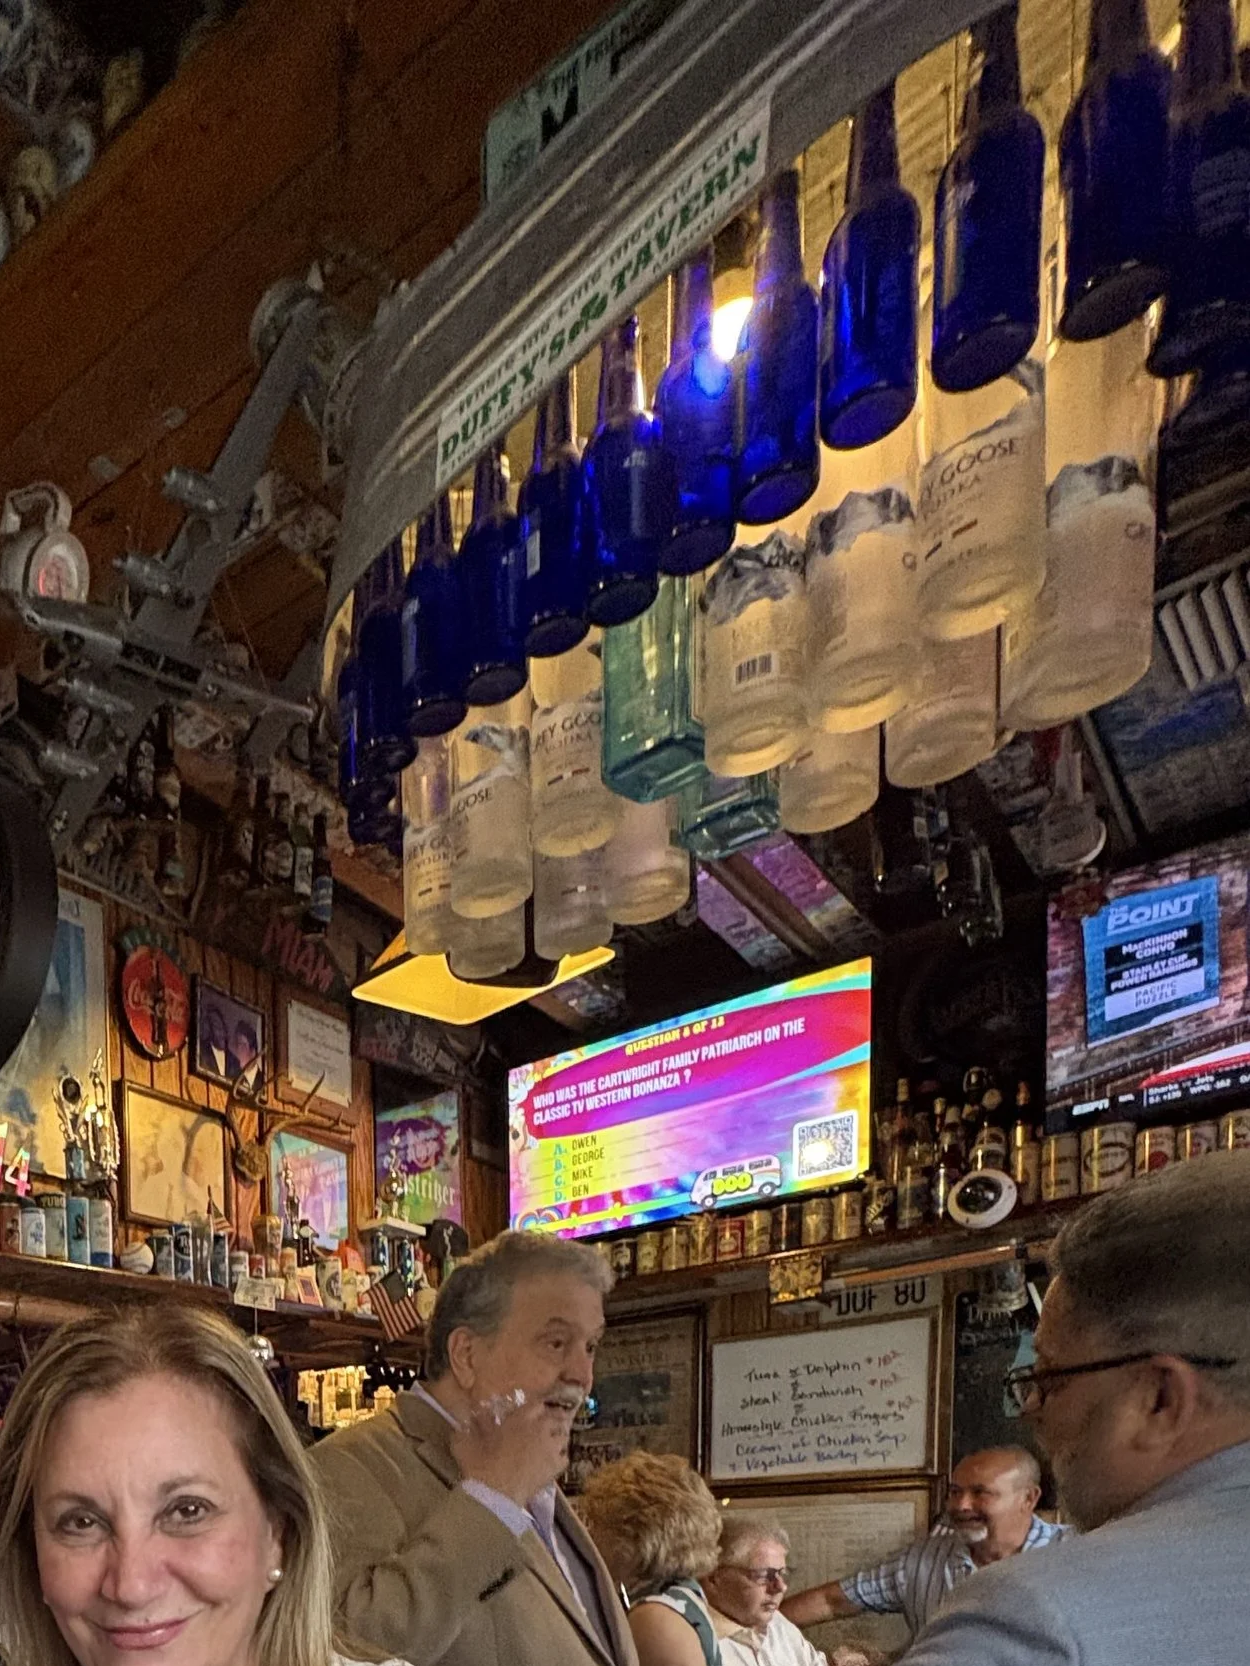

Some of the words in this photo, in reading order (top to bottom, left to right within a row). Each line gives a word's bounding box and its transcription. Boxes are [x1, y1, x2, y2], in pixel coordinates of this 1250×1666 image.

[441, 331, 566, 464] DUFFY'S
[612, 134, 760, 294] TAVERN
[940, 438, 1021, 487] GOOSE
[1108, 893, 1200, 934] POINT
[1135, 942, 1176, 959] CONVO
[1122, 959, 1166, 980] STANLEY
[1168, 953, 1188, 967] CUP
[1110, 974, 1148, 992] POWER
[1135, 980, 1177, 998] PACIFIC
[1135, 989, 1177, 1008] PUZZLE
[624, 1028, 680, 1056] QUESTION
[693, 1022, 707, 1036] OF
[533, 1092, 555, 1110] WHO
[556, 1086, 577, 1104] WAS
[578, 1080, 597, 1099] THE
[597, 1060, 661, 1090] CARTWRIGHT
[662, 1047, 701, 1074] FAMILY
[701, 1028, 762, 1060] PATRIARCH
[764, 1023, 781, 1042] ON
[782, 1017, 806, 1037] THE
[533, 1105, 571, 1127] CLASSIC
[572, 1101, 585, 1117] TV
[585, 1085, 632, 1114] WESTERN
[633, 1074, 680, 1099] BONANZA
[683, 1068, 692, 1085] ?
[554, 1143, 568, 1157] A.
[571, 1133, 597, 1151] OWEN
[554, 1159, 567, 1172] B.
[571, 1146, 606, 1167] GEORGE
[554, 1174, 566, 1188] C.
[571, 1167, 595, 1182] MIKE
[554, 1190, 567, 1203] D.
[571, 1184, 590, 1198] BEN
[744, 1368, 782, 1383] Tuna
[803, 1360, 862, 1378] Dolphin
[791, 1412, 844, 1429] Chicken
[849, 1405, 905, 1427] Fingers
[816, 1432, 872, 1448] Chicken
[874, 1429, 907, 1449] Soup
[745, 1453, 809, 1473] Vegetable
